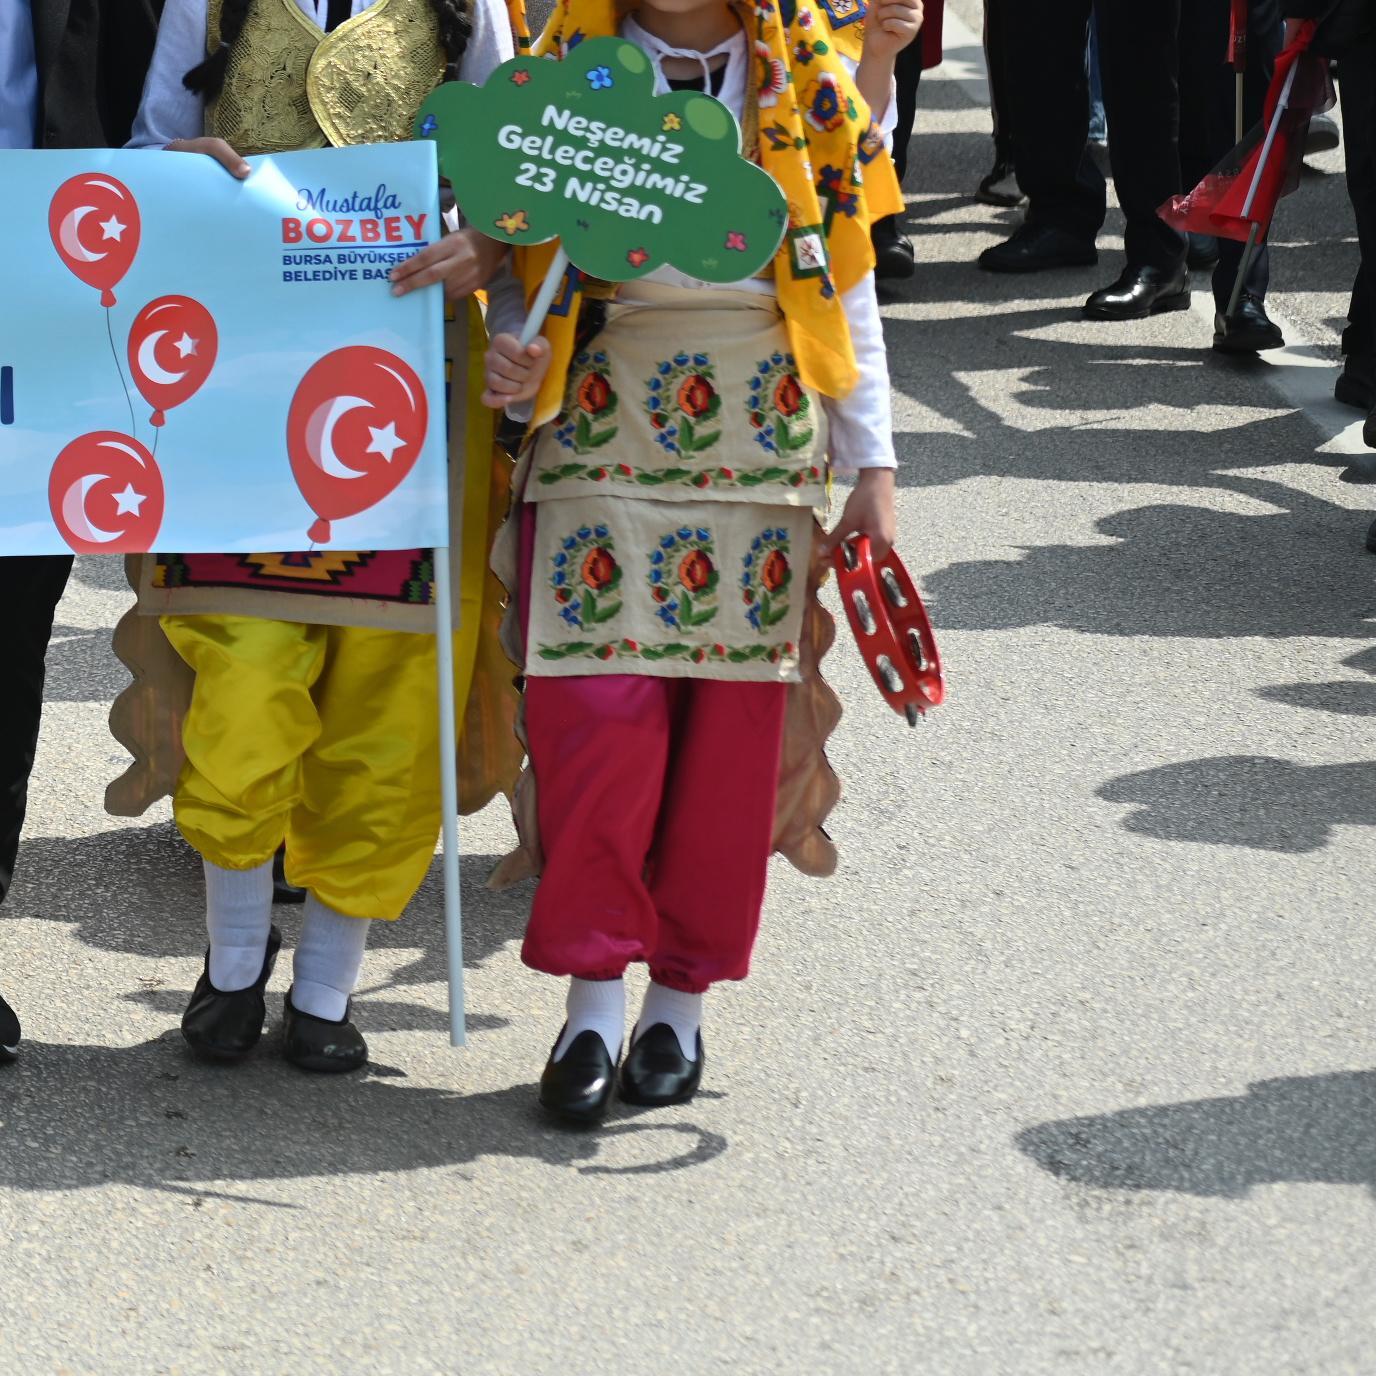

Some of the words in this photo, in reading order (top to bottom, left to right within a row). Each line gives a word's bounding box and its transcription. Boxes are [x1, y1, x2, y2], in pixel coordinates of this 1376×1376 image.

[540, 104, 685, 165] Neşemiz
[497, 124, 709, 205] Geleceğimiz
[296, 183, 402, 219] Mustafa
[514, 162, 558, 193] 23
[563, 176, 664, 225] Nisan
[281, 213, 427, 244] BOZBEY
[282, 253, 333, 266] BURSA
[282, 266, 358, 282] BELEDİYE
